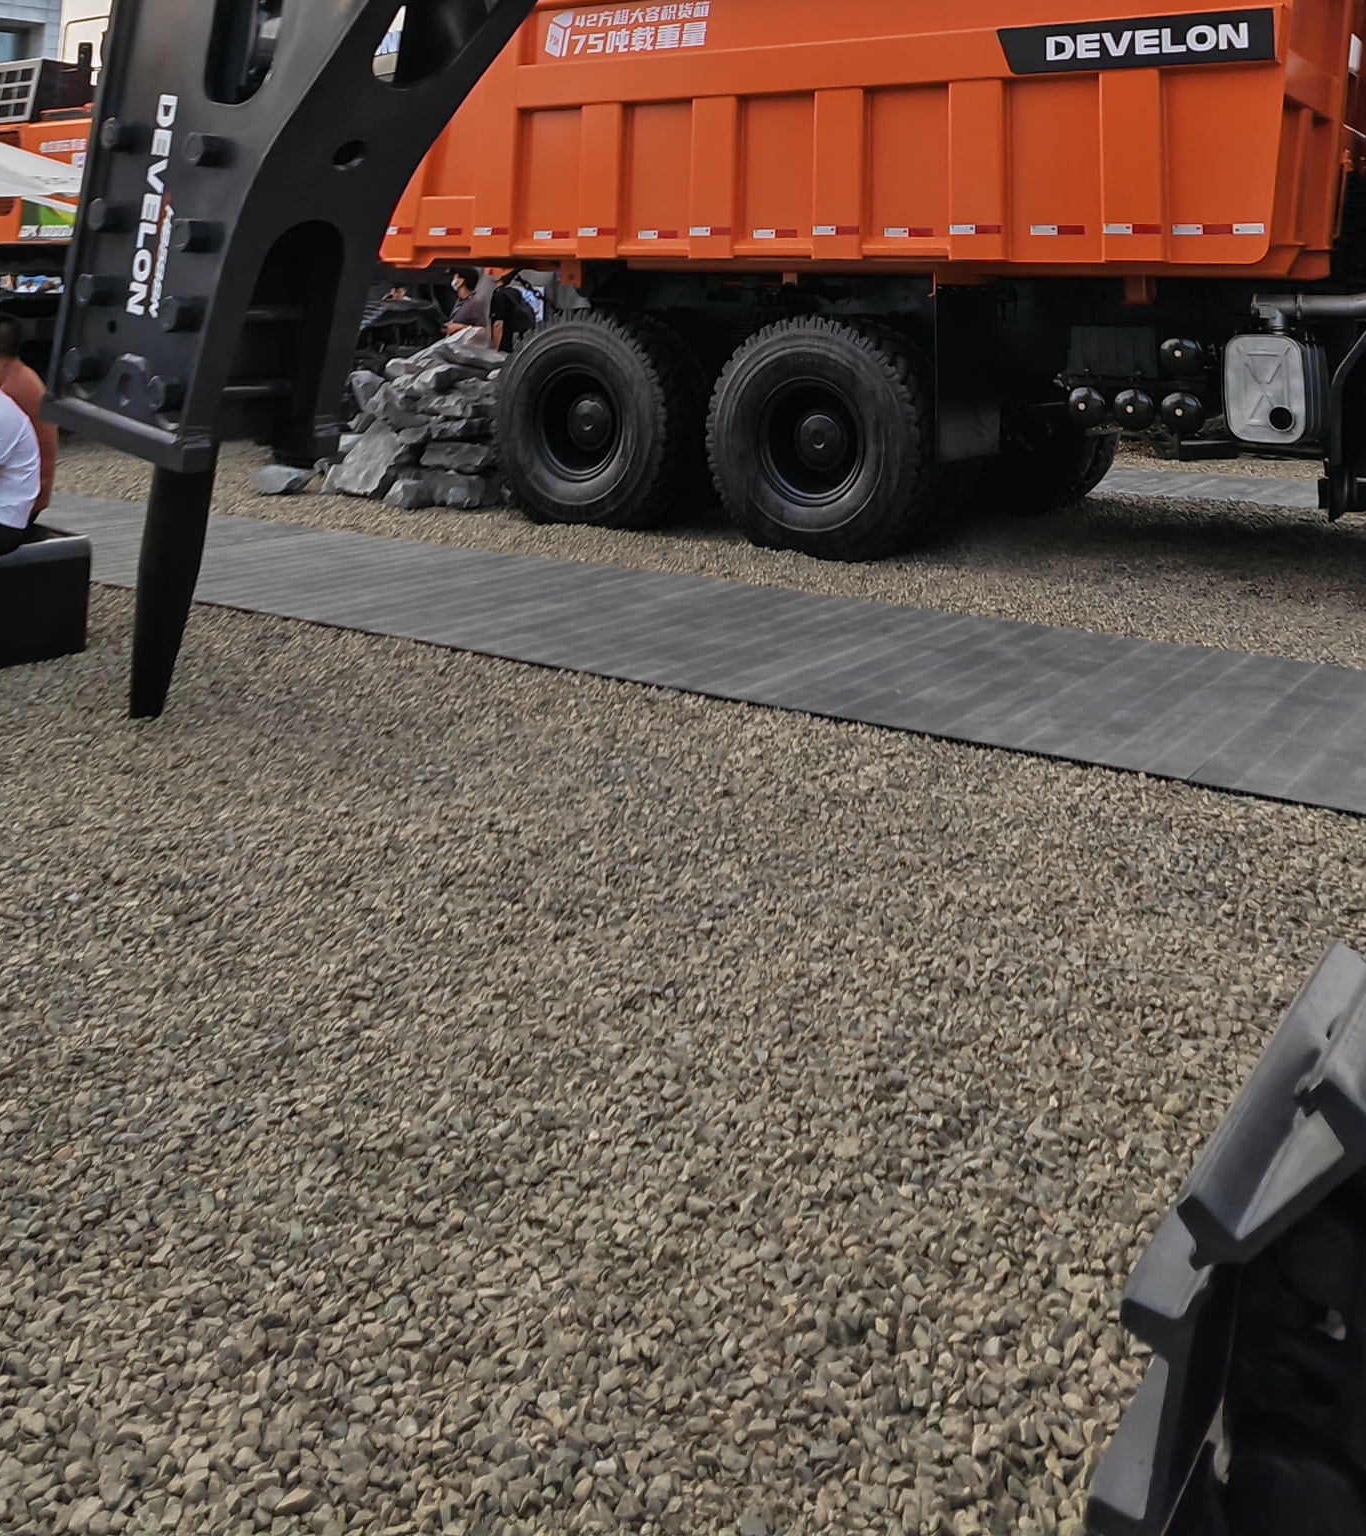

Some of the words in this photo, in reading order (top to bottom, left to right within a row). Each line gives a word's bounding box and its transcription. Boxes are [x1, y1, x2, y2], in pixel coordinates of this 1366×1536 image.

[574, 0, 711, 28] 42方超大容积货箱
[570, 21, 708, 55] 75吨载重量
[1045, 21, 1250, 62] DEVELON
[125, 93, 179, 316] DEVELON
